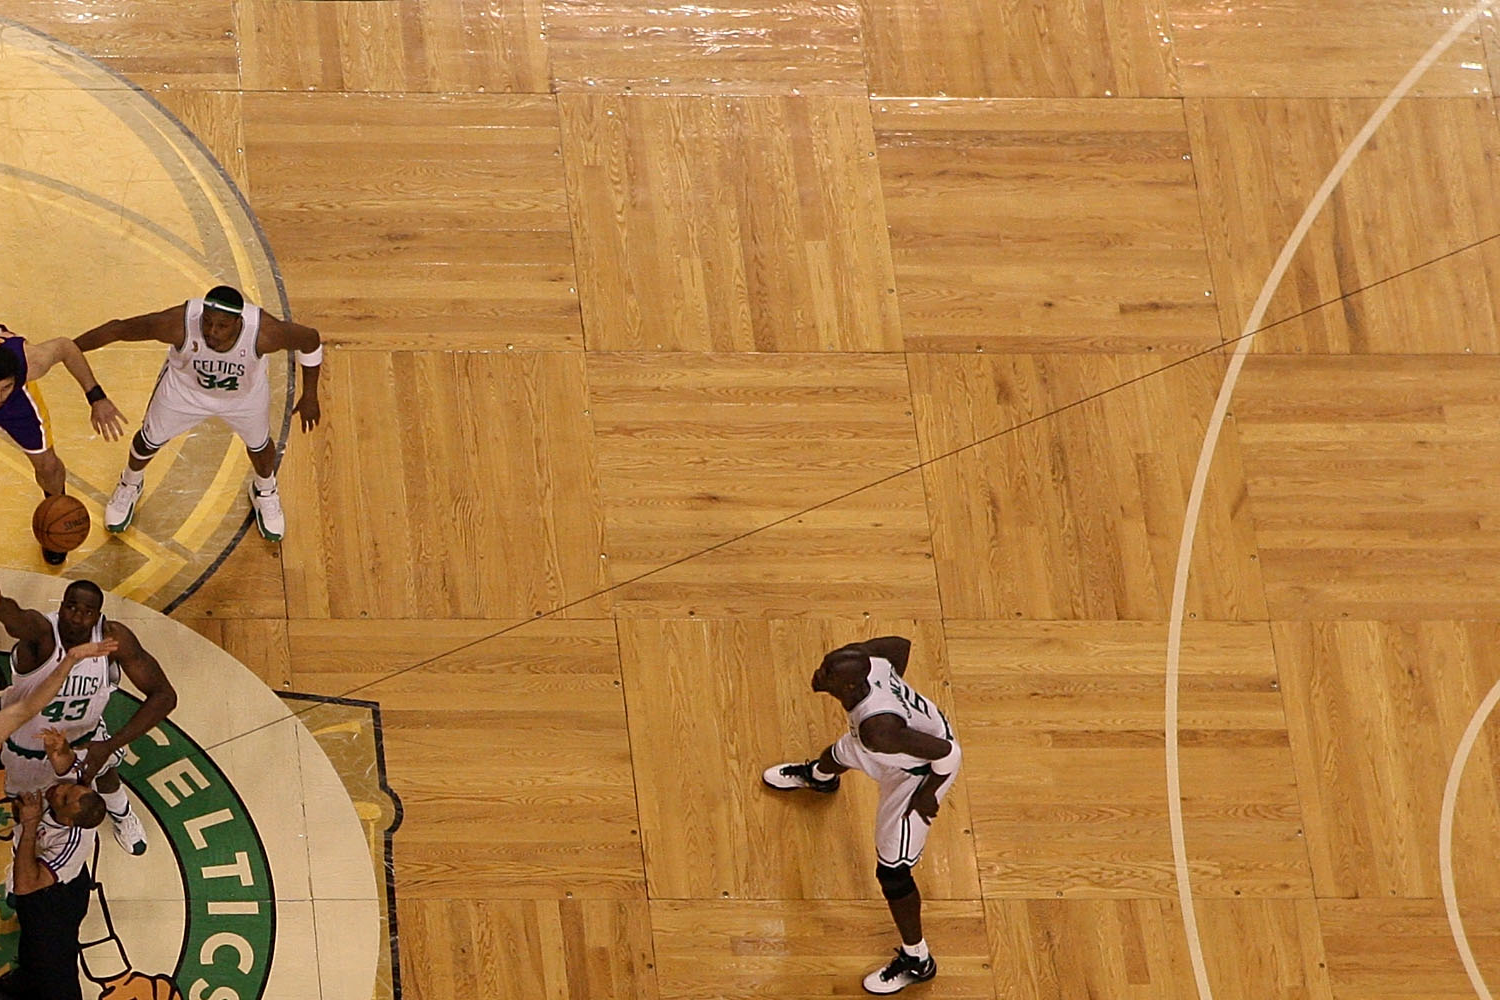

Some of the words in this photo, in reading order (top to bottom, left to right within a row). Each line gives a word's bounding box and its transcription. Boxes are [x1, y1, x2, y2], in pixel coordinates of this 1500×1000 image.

[193, 359, 245, 377] CELTICS
[196, 369, 240, 391] 34
[56, 675, 99, 697] LTICS
[41, 698, 92, 723] 43
